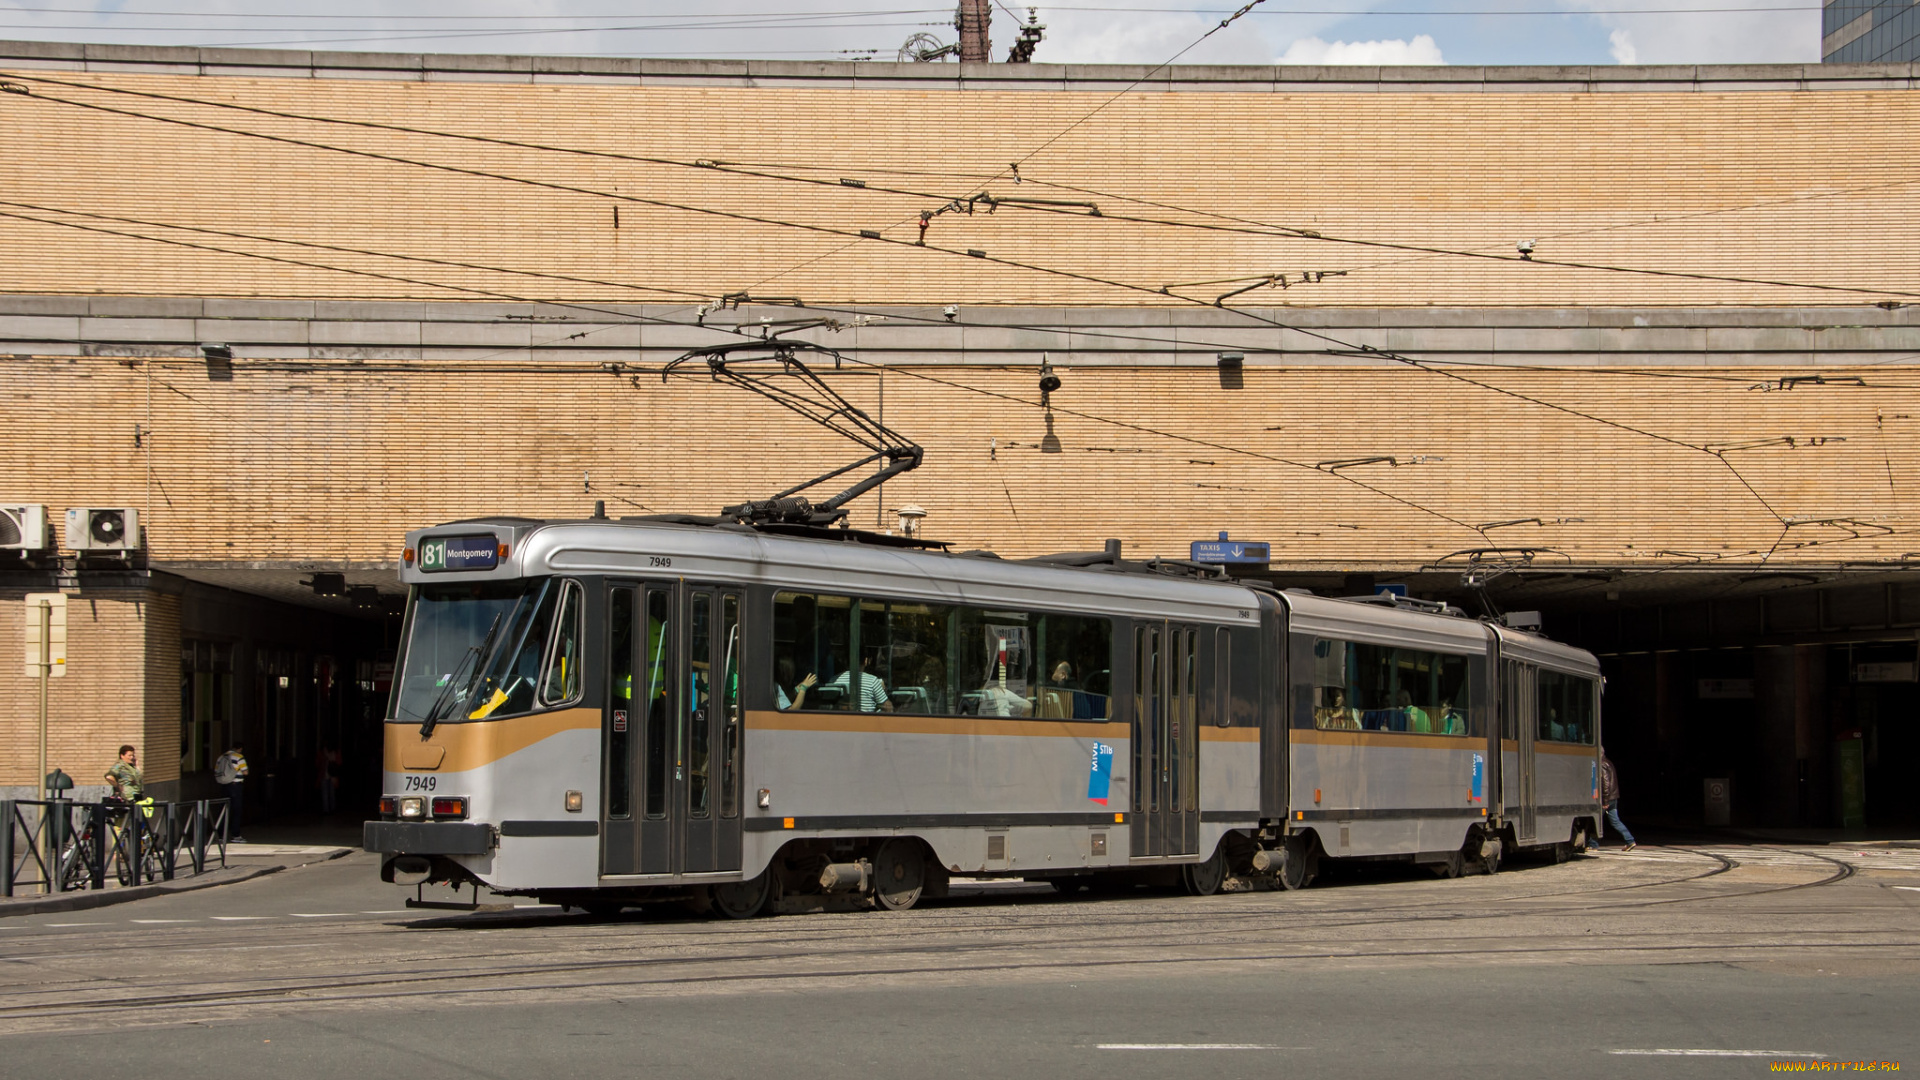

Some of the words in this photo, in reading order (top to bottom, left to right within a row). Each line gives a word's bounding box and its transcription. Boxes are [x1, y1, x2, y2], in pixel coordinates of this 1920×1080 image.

[425, 544, 443, 564] 81
[447, 549, 493, 560] Montgomery
[649, 556, 671, 567] 7949
[405, 776, 437, 791] 7949
